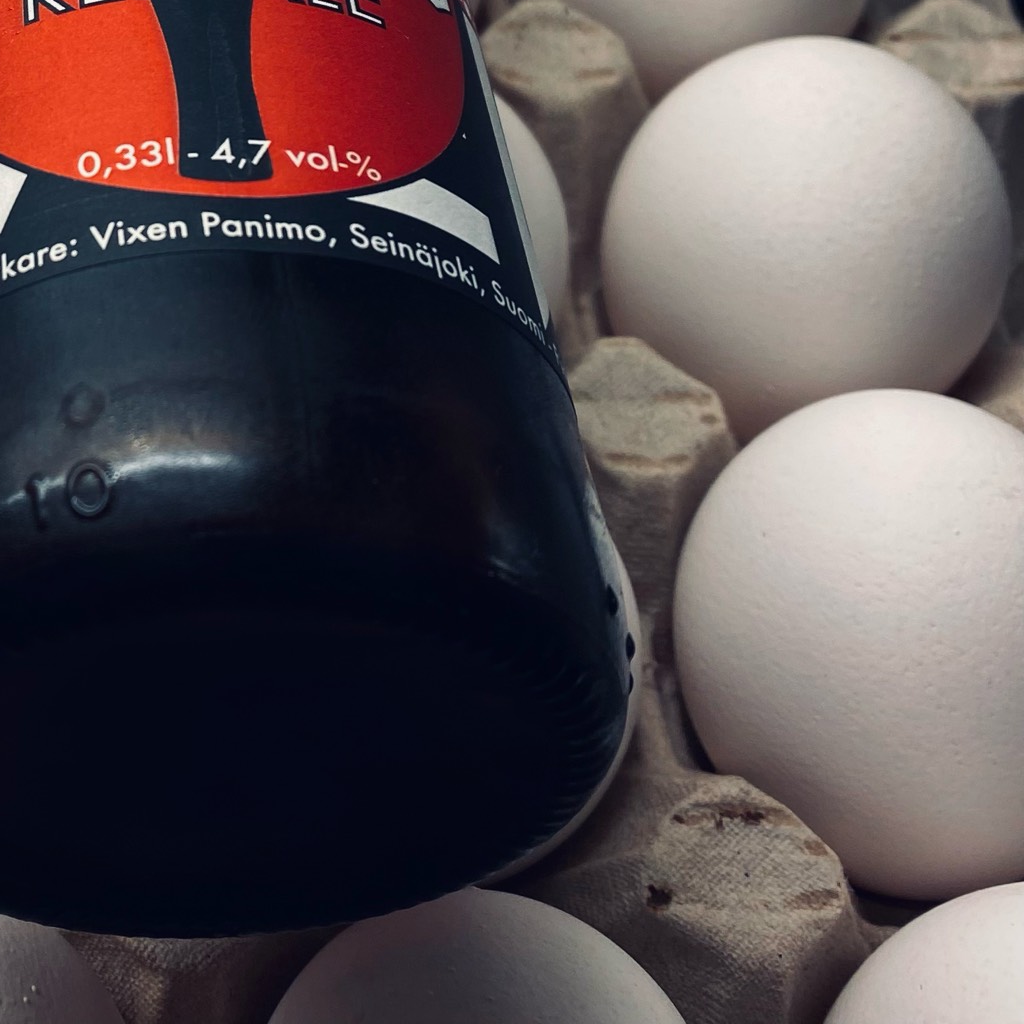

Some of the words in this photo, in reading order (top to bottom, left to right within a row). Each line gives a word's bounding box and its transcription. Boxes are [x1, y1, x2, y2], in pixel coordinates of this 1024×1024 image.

[76, 137, 176, 181] 0,33l
[210, 138, 273, 171] 4,7
[284, 144, 383, 182] vol-%
[89, 218, 189, 252] Vixen
[202, 211, 337, 250] Panimo,
[350, 222, 485, 297] Seinäjoki,
[491, 279, 546, 346] Suomi
